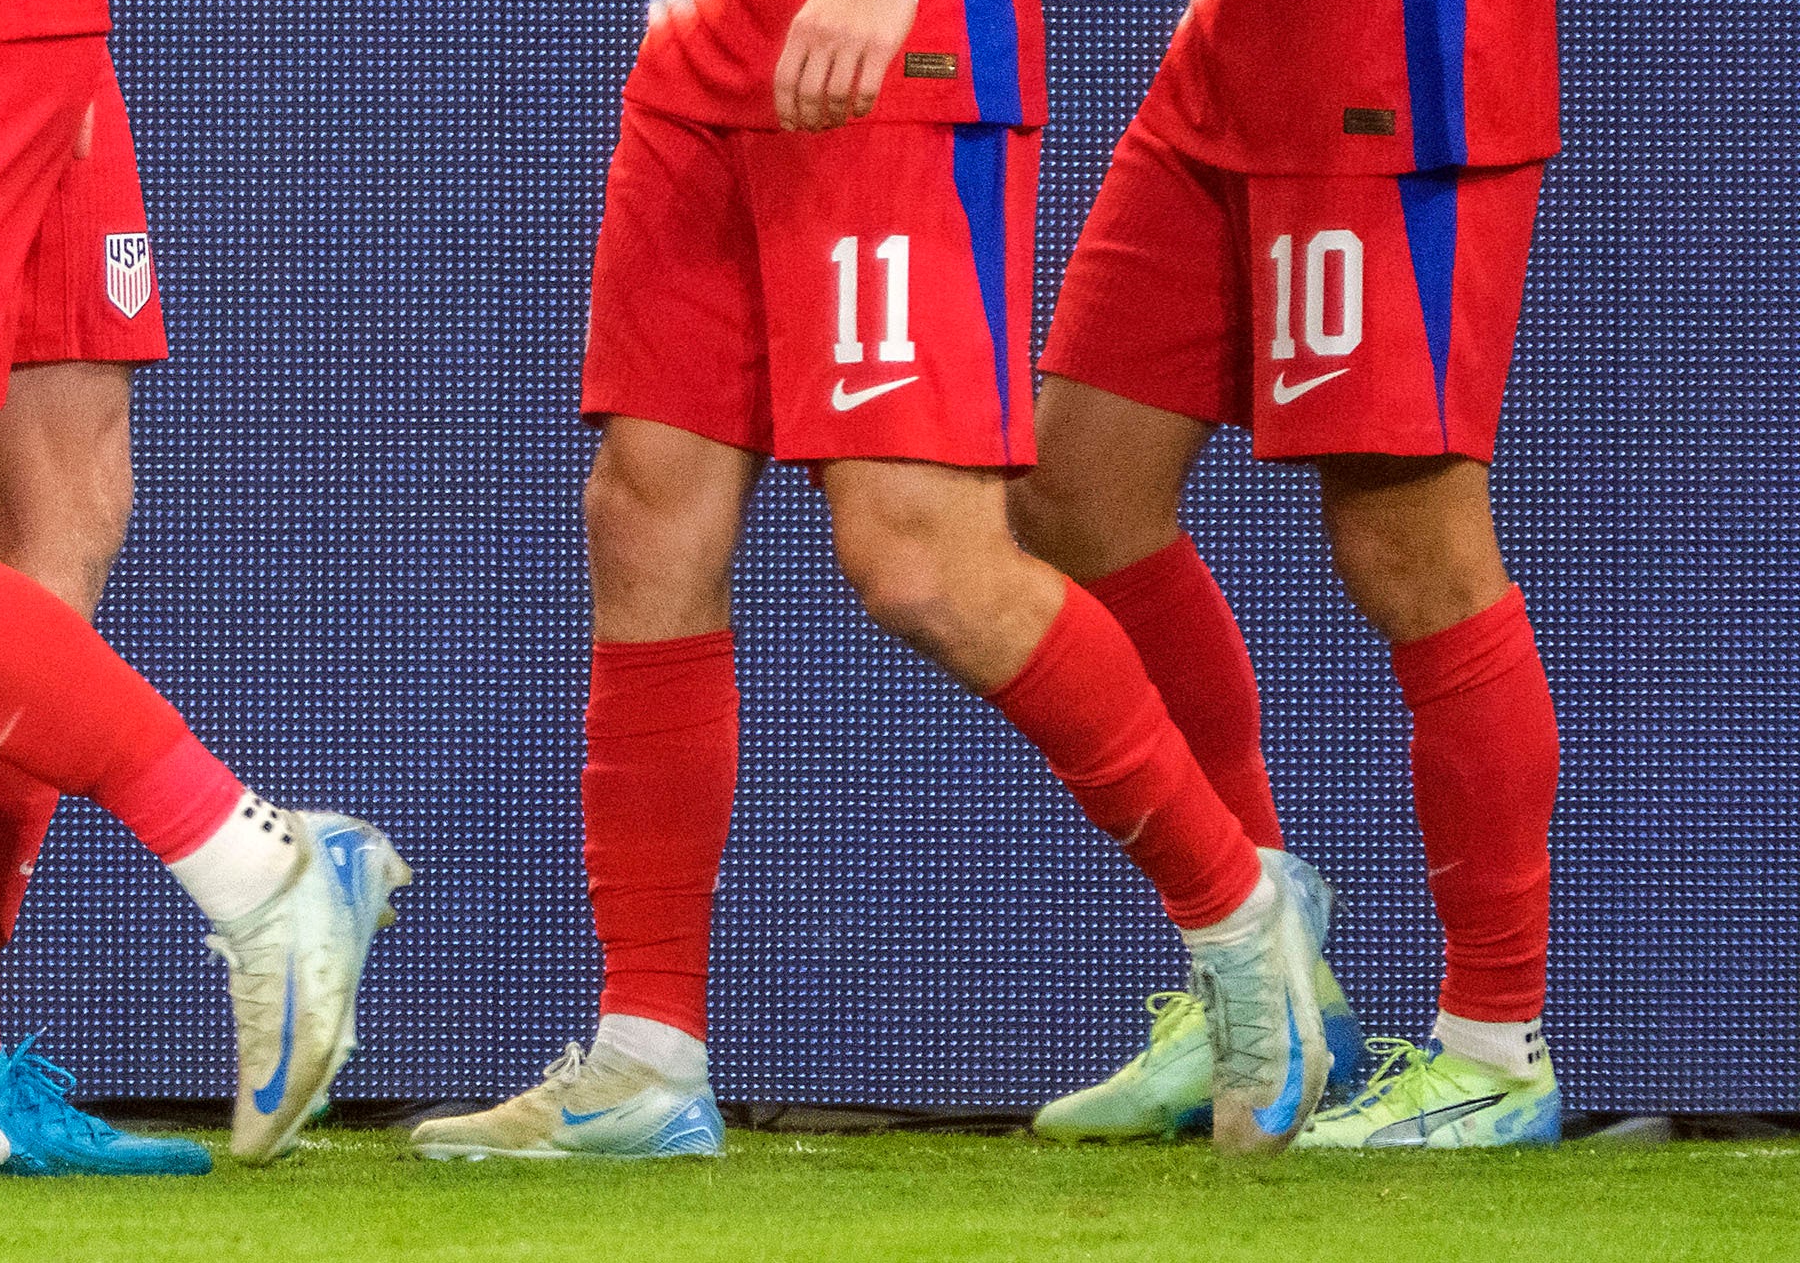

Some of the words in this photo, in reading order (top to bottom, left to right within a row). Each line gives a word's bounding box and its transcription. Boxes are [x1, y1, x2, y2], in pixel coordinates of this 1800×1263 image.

[109, 237, 146, 269] USA
[831, 235, 916, 364] 11
[1270, 229, 1364, 359] 10
